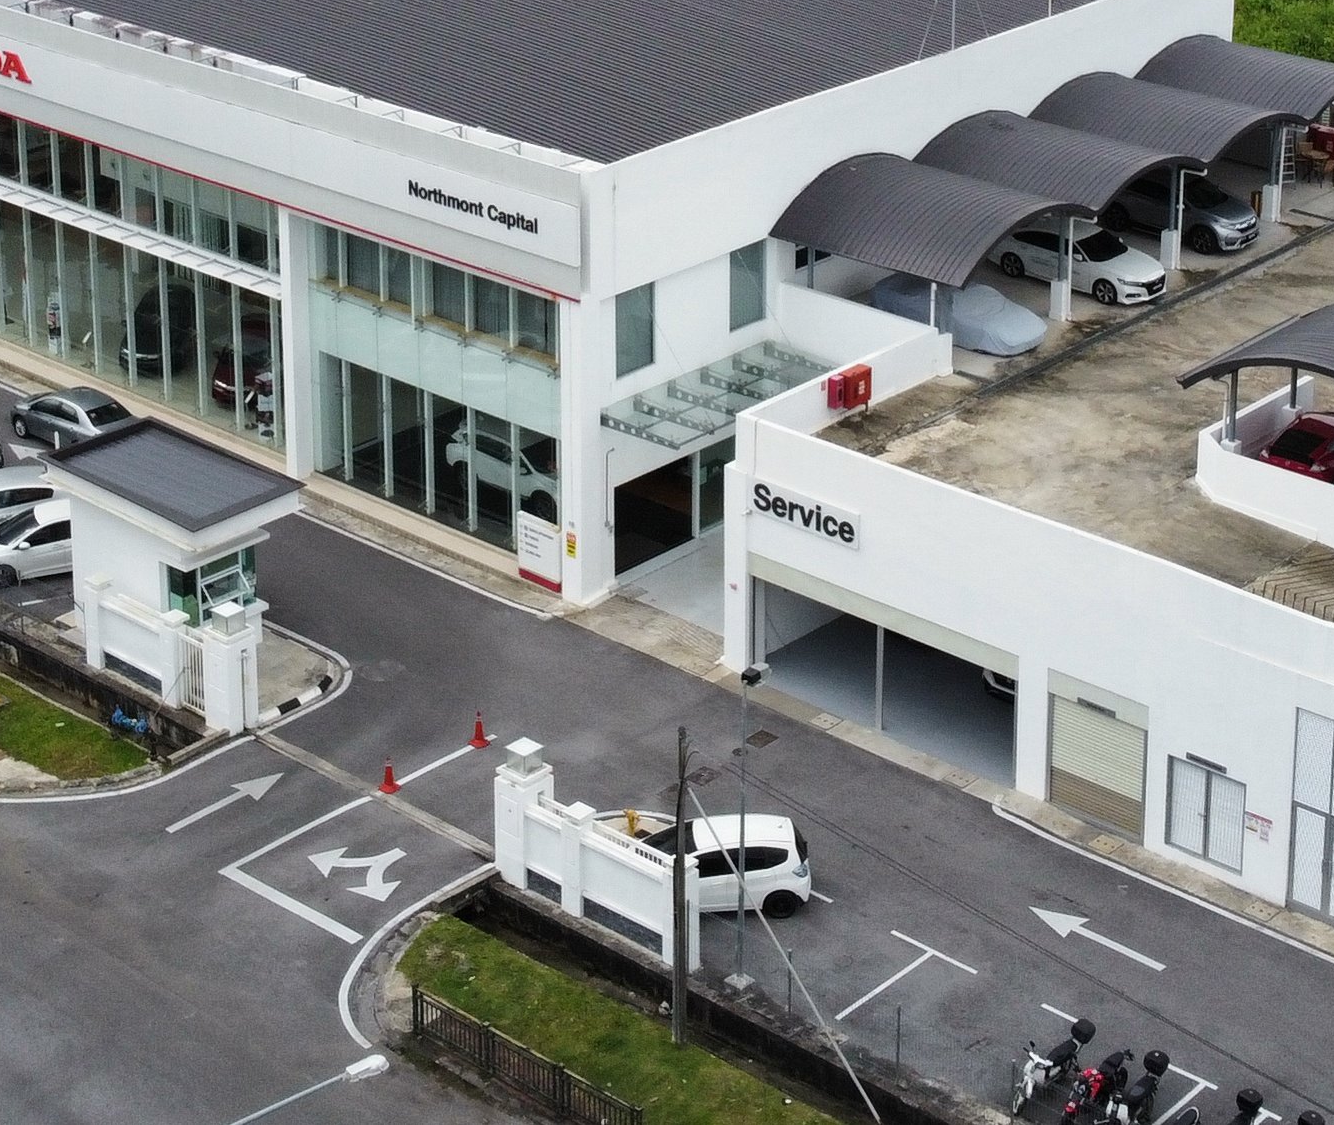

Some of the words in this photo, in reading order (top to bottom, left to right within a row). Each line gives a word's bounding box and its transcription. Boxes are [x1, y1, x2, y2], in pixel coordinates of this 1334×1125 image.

[408, 179, 484, 218] Northmont
[487, 204, 539, 235] Capital
[753, 483, 855, 543] Service
